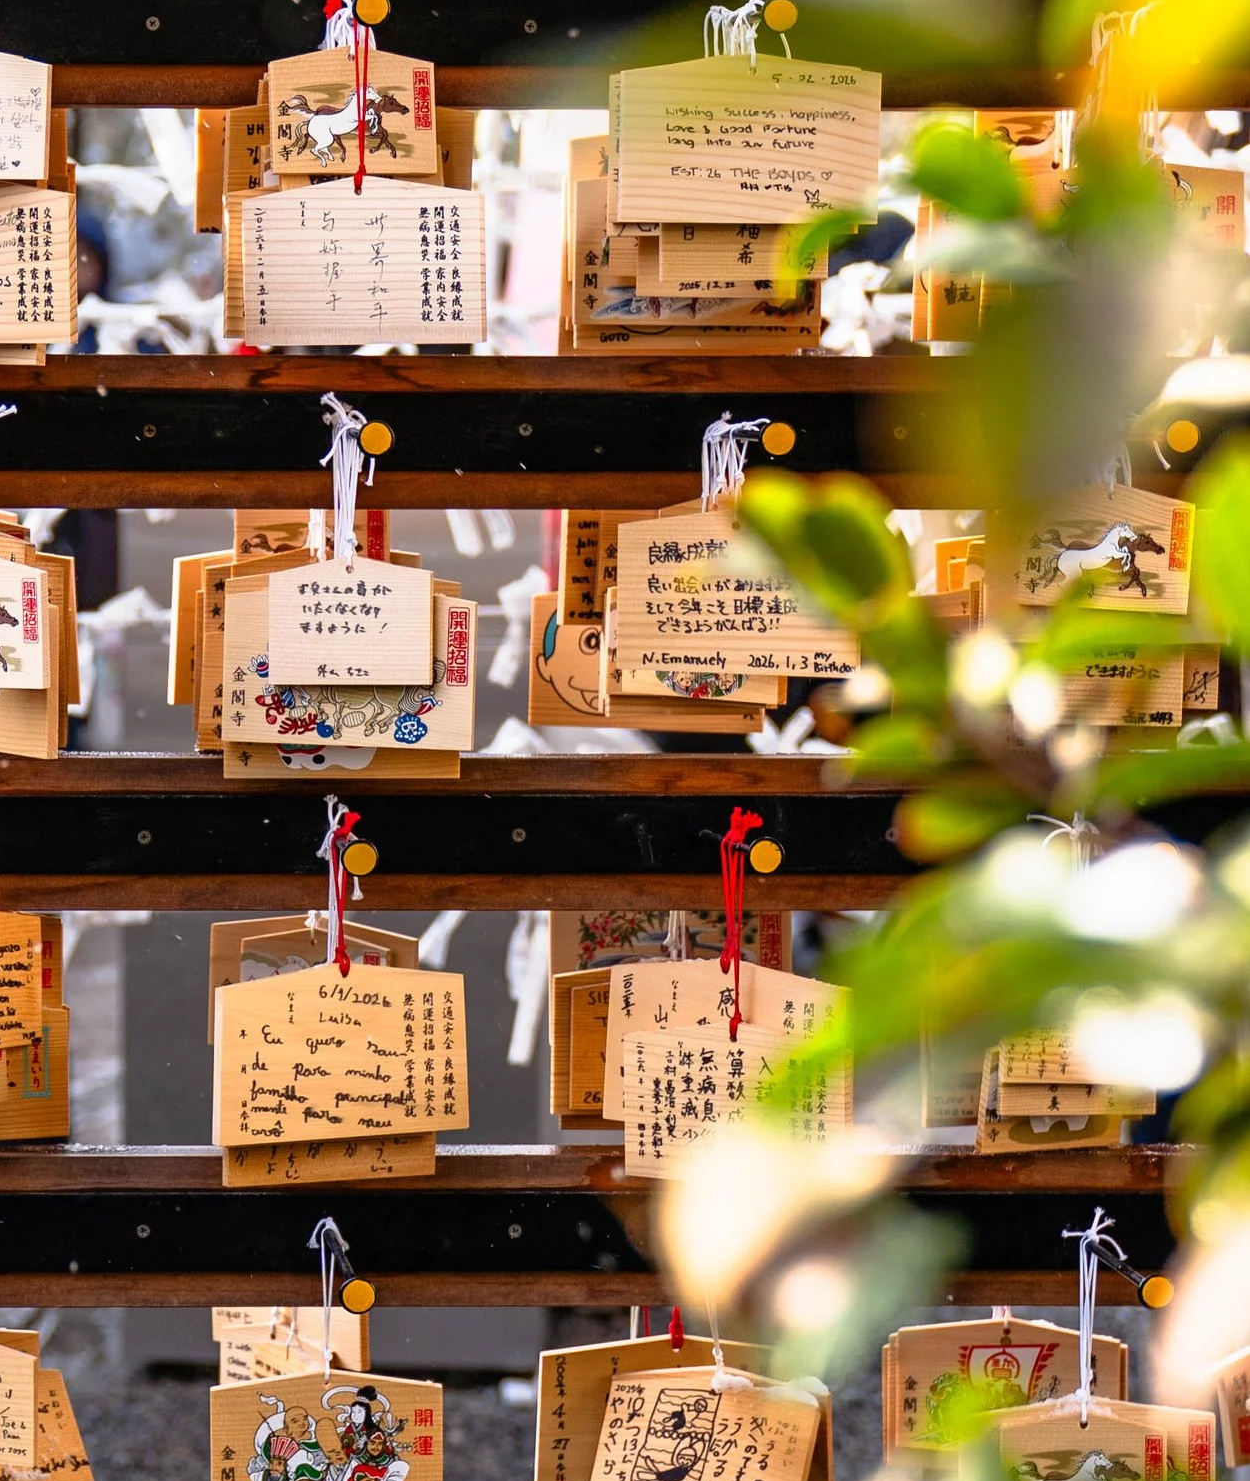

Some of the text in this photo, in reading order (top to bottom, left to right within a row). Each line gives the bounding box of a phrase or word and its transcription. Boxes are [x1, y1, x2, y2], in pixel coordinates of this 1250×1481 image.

[278, 101, 293, 160] 金閣寺
[17, 268, 28, 322] 学業成就
[29, 207, 40, 322] 開運招福 家内安全
[43, 207, 54, 322] 交通安全 良縁成就
[419, 207, 433, 321] 無病息災 学業成就
[434, 207, 447, 321] 開運招福 家内安全
[450, 206, 463, 321] 交通安全 良縁成就
[584, 251, 599, 309] 金閣寺
[231, 667, 246, 726] 金閣寺
[403, 993, 415, 1053] 無病息災
[423, 993, 436, 1116] 開運招福 家内安全
[443, 992, 456, 1115] 交通安全 良縁成就
[414, 1409, 433, 1456] 開運
[904, 1376, 917, 1432] 金閣寺
